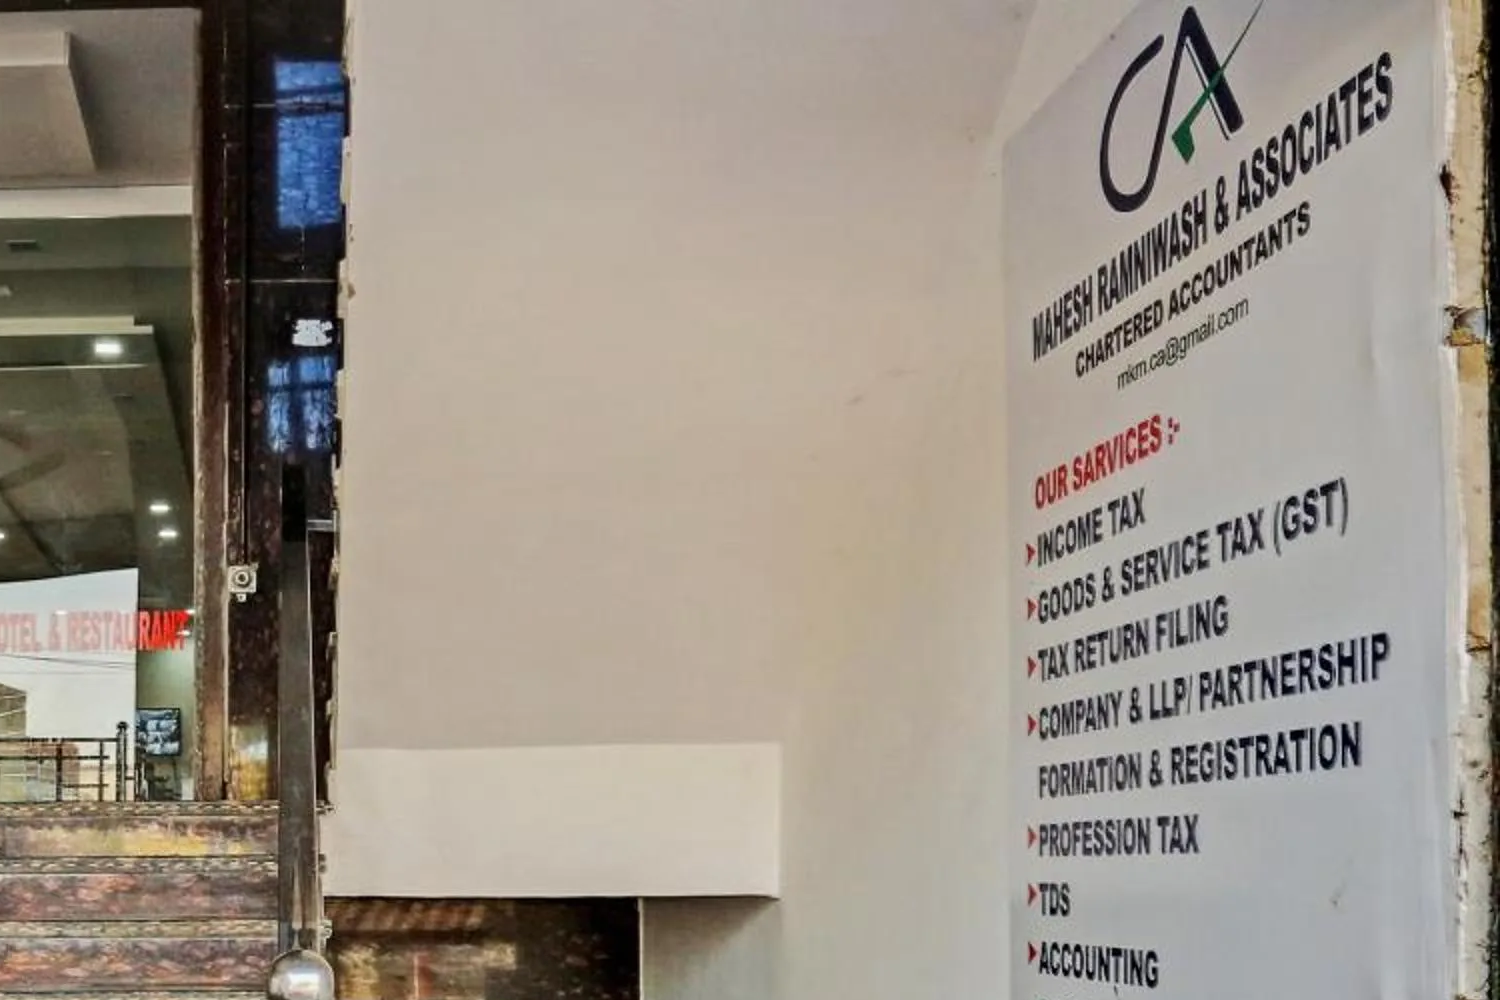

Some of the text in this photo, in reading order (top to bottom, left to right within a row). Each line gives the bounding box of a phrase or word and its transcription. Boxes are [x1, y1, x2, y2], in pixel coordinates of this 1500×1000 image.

[1032, 51, 1393, 361] MAHESH RAMNIWASH & ASSOCIATES
[1075, 200, 1311, 378] CHARTERED ACCOUNTANTS
[1116, 298, 1249, 390] mkm.ca@gmail.com
[1035, 463, 1068, 510] OUR
[1073, 414, 1162, 491] SARVICES
[1038, 487, 1146, 567] INCOME TAX
[1038, 477, 1349, 624] GOODS & SERVICE TAX (GST)
[67, 608, 190, 652] RESTAURANT
[1038, 595, 1229, 683] TAX RETURN FILING
[1038, 690, 1123, 741] COMPANY
[1130, 687, 1143, 724] &
[1199, 632, 1391, 712] PARTNERSHIP
[1039, 721, 1363, 799] FORMATION & REGISTRATION
[1039, 814, 1199, 857] PROFESSION TAX
[1039, 882, 1071, 917] TDS
[1039, 941, 1160, 989] ACCOUNTING
